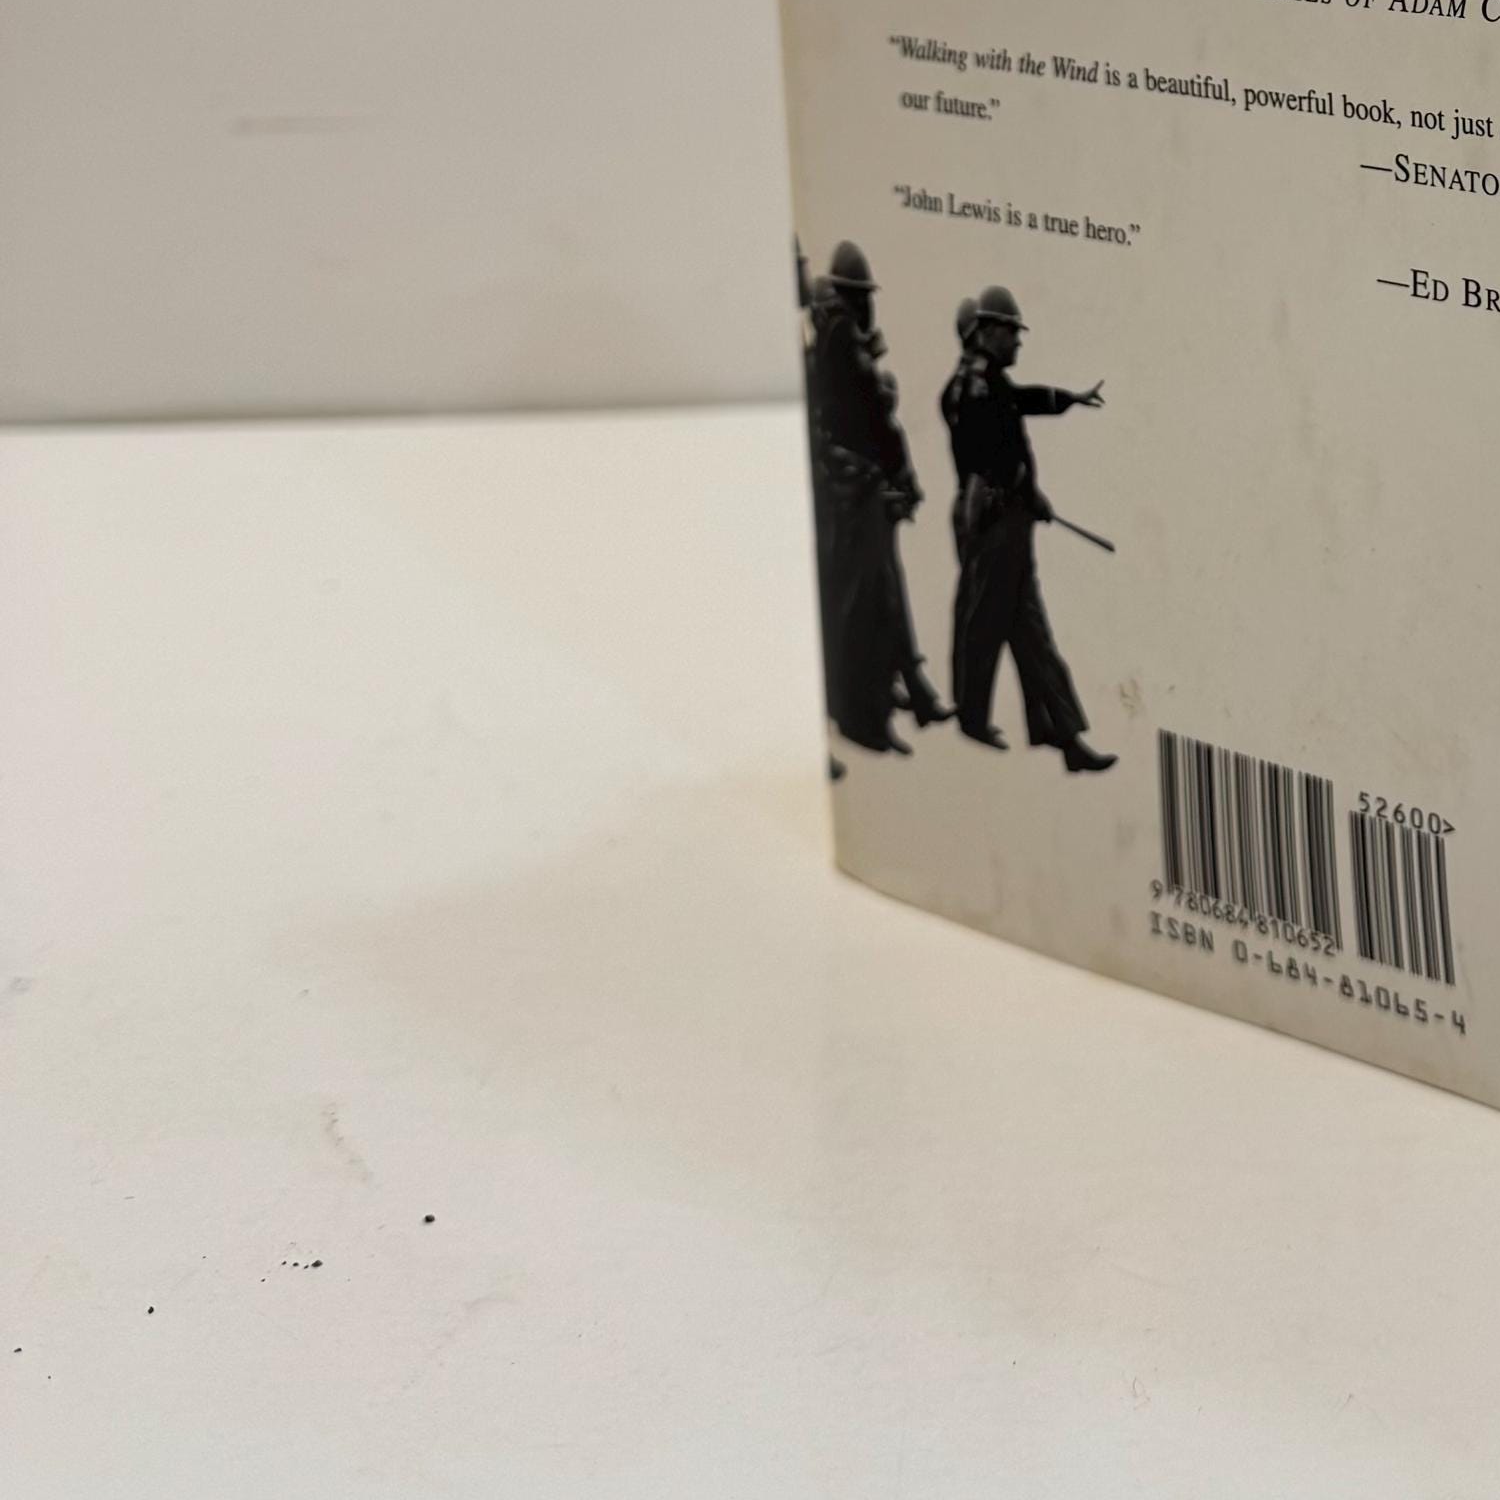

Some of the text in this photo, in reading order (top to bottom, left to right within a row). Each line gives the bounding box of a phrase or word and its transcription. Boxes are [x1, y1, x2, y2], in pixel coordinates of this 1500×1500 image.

[899, 92, 931, 111] our
[973, 48, 1012, 73] with
[1016, 52, 1046, 77] the
[1051, 55, 1099, 84] Wind
[1104, 62, 1121, 87] is
[1126, 72, 1139, 90] a
[1143, 68, 1236, 106] beautiful,
[1243, 88, 1335, 116] powerful
[1341, 94, 1402, 129] book,
[1410, 110, 1446, 131] not
[1451, 109, 1495, 140] just
[947, 193, 1002, 224] Lewis
[1005, 202, 1022, 227] is
[1026, 212, 1038, 230] a
[1042, 213, 1079, 237] true
[1150, 911, 1467, 1035] ISBN 0-684-81065-4
